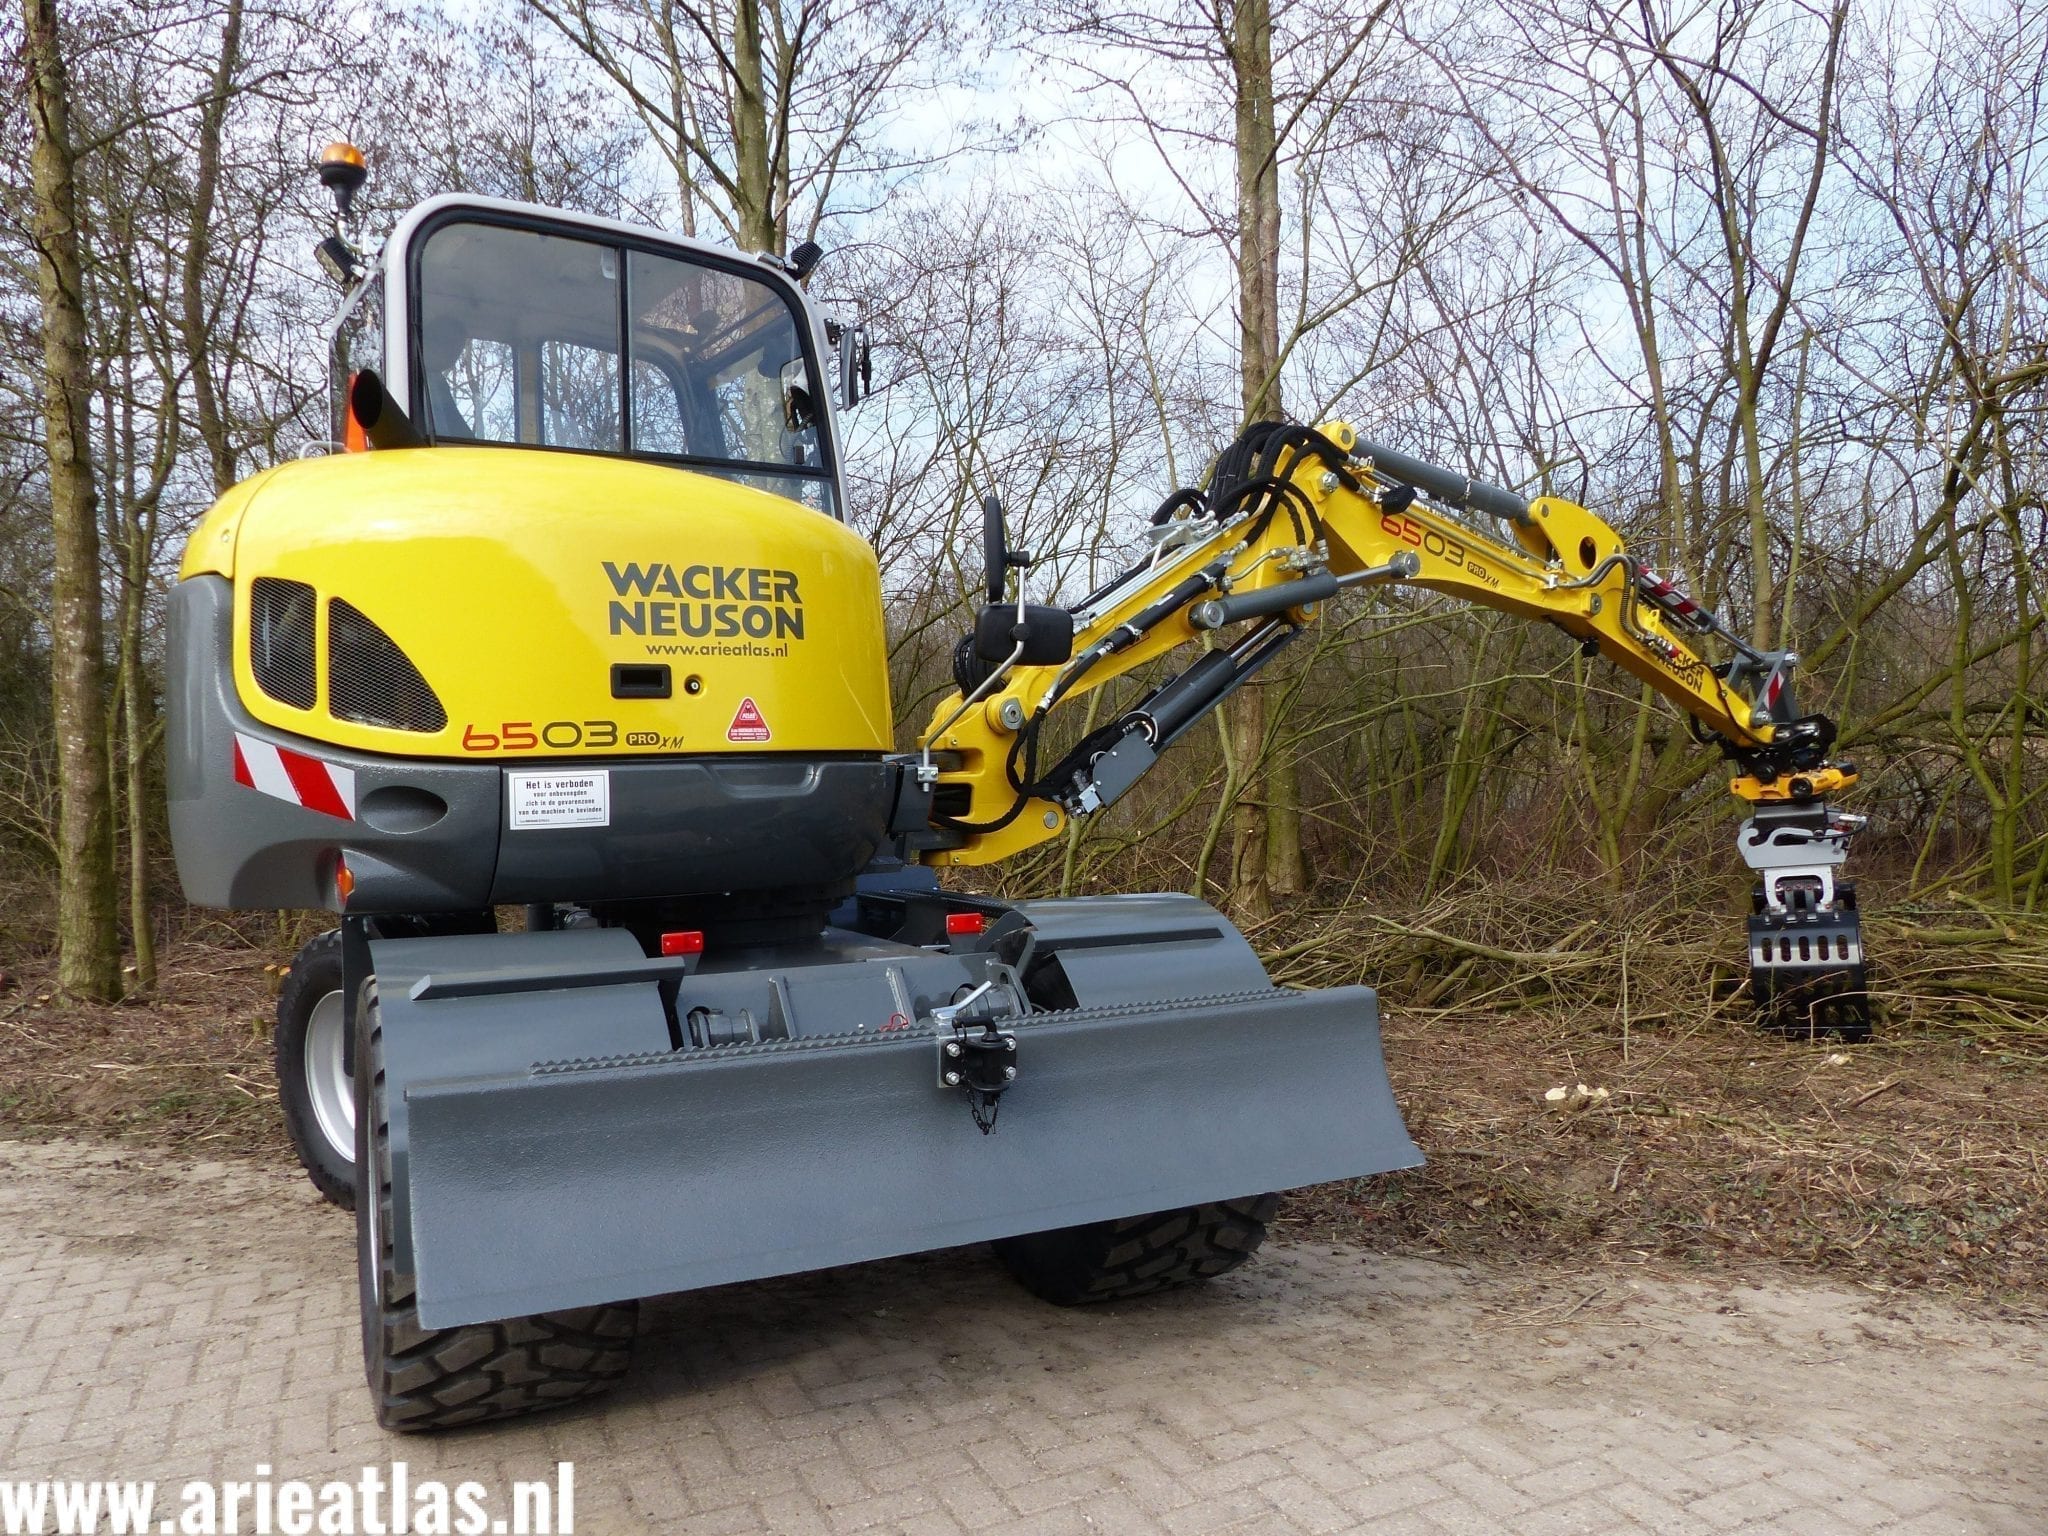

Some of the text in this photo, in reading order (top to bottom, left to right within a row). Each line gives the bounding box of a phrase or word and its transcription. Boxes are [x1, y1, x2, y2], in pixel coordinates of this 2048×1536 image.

[1380, 514, 1465, 567] 6503
[1468, 563, 1486, 577] PRO
[601, 561, 803, 604] WACKER
[608, 600, 805, 640] NEUSON
[645, 642, 788, 657] www.arieatlas.nl
[461, 719, 619, 751] 6503
[627, 732, 659, 746] PRO
[526, 779, 594, 789] Het is verboden
